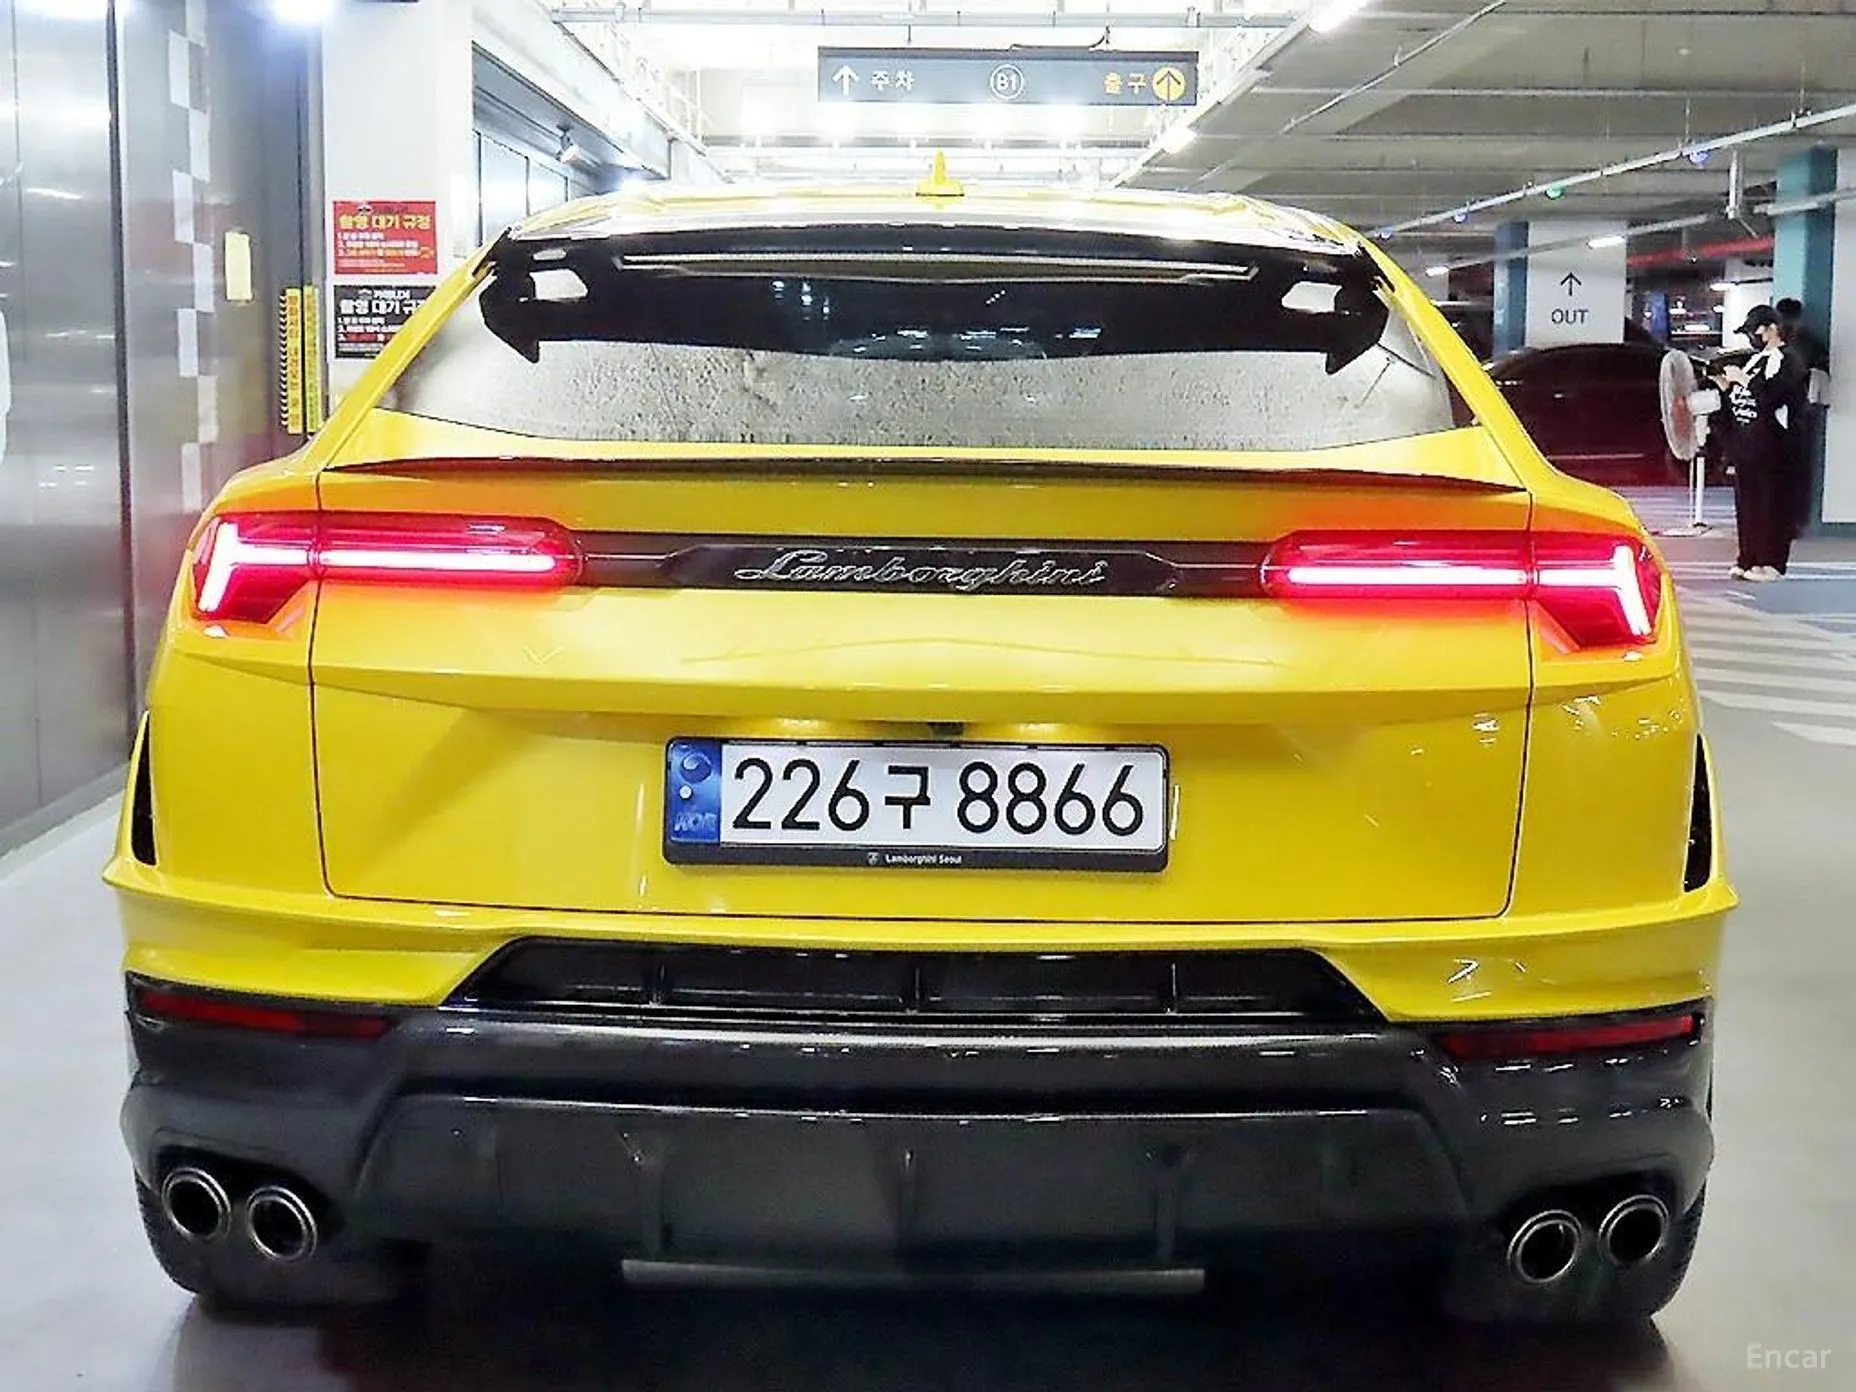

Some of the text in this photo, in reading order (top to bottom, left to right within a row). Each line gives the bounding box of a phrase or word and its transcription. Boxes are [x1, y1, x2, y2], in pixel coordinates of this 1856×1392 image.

[870, 70, 915, 92] 주차
[995, 73, 1019, 91] B1
[1104, 72, 1147, 95] 출구
[371, 214, 400, 230] 대기
[403, 214, 431, 230] 규정
[371, 299, 400, 315] 대기
[1551, 308, 1589, 325] OUT
[734, 550, 1108, 591] Lamborghini
[731, 756, 1145, 836] 226구 8866
